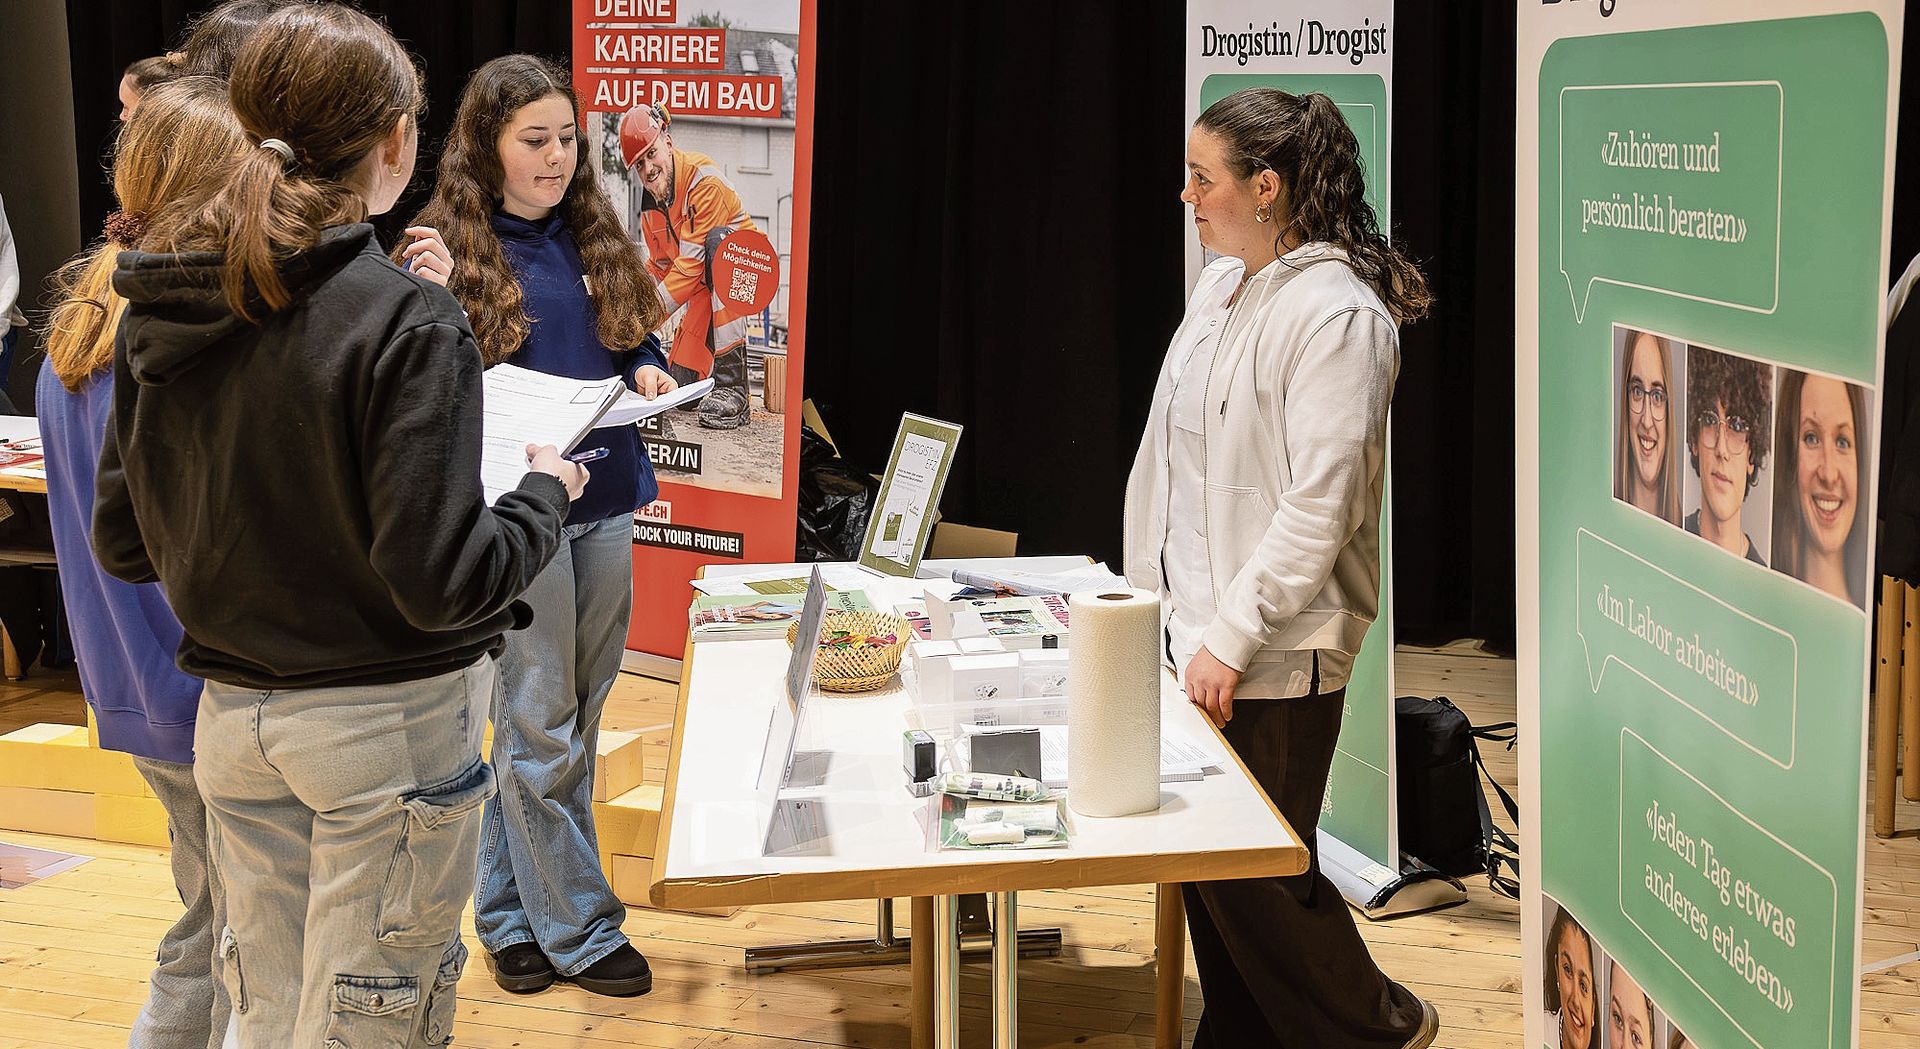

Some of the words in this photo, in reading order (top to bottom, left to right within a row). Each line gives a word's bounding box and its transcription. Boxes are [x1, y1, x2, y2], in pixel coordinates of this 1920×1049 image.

[594, 0, 671, 17] DEINE
[594, 34, 720, 63] KARRIERE
[1201, 21, 1293, 66] Drogistin
[1307, 17, 1387, 66] Drogist
[594, 79, 645, 107] AUF
[651, 80, 710, 109] DEM
[717, 82, 776, 111] BAU
[1601, 129, 1679, 171] «Zuhören
[1683, 131, 1721, 173] und
[1581, 192, 1665, 233] persönlich
[1668, 195, 1748, 243] beraten»
[722, 251, 772, 273] Möglichkeiten
[727, 242, 750, 256] Check
[751, 250, 771, 262] deine
[633, 524, 662, 543] ROCK
[664, 528, 692, 547] YOUR
[694, 532, 740, 553] FUTURE!
[1597, 583, 1625, 627] «Im
[1627, 597, 1672, 656] Labor
[1675, 633, 1759, 706] arbeiten»
[1645, 799, 1697, 868] «Jeden
[1700, 837, 1731, 906] Tag
[1734, 879, 1796, 948] etwas
[1645, 863, 1708, 940] anderes
[1712, 925, 1794, 1014] erleben»
